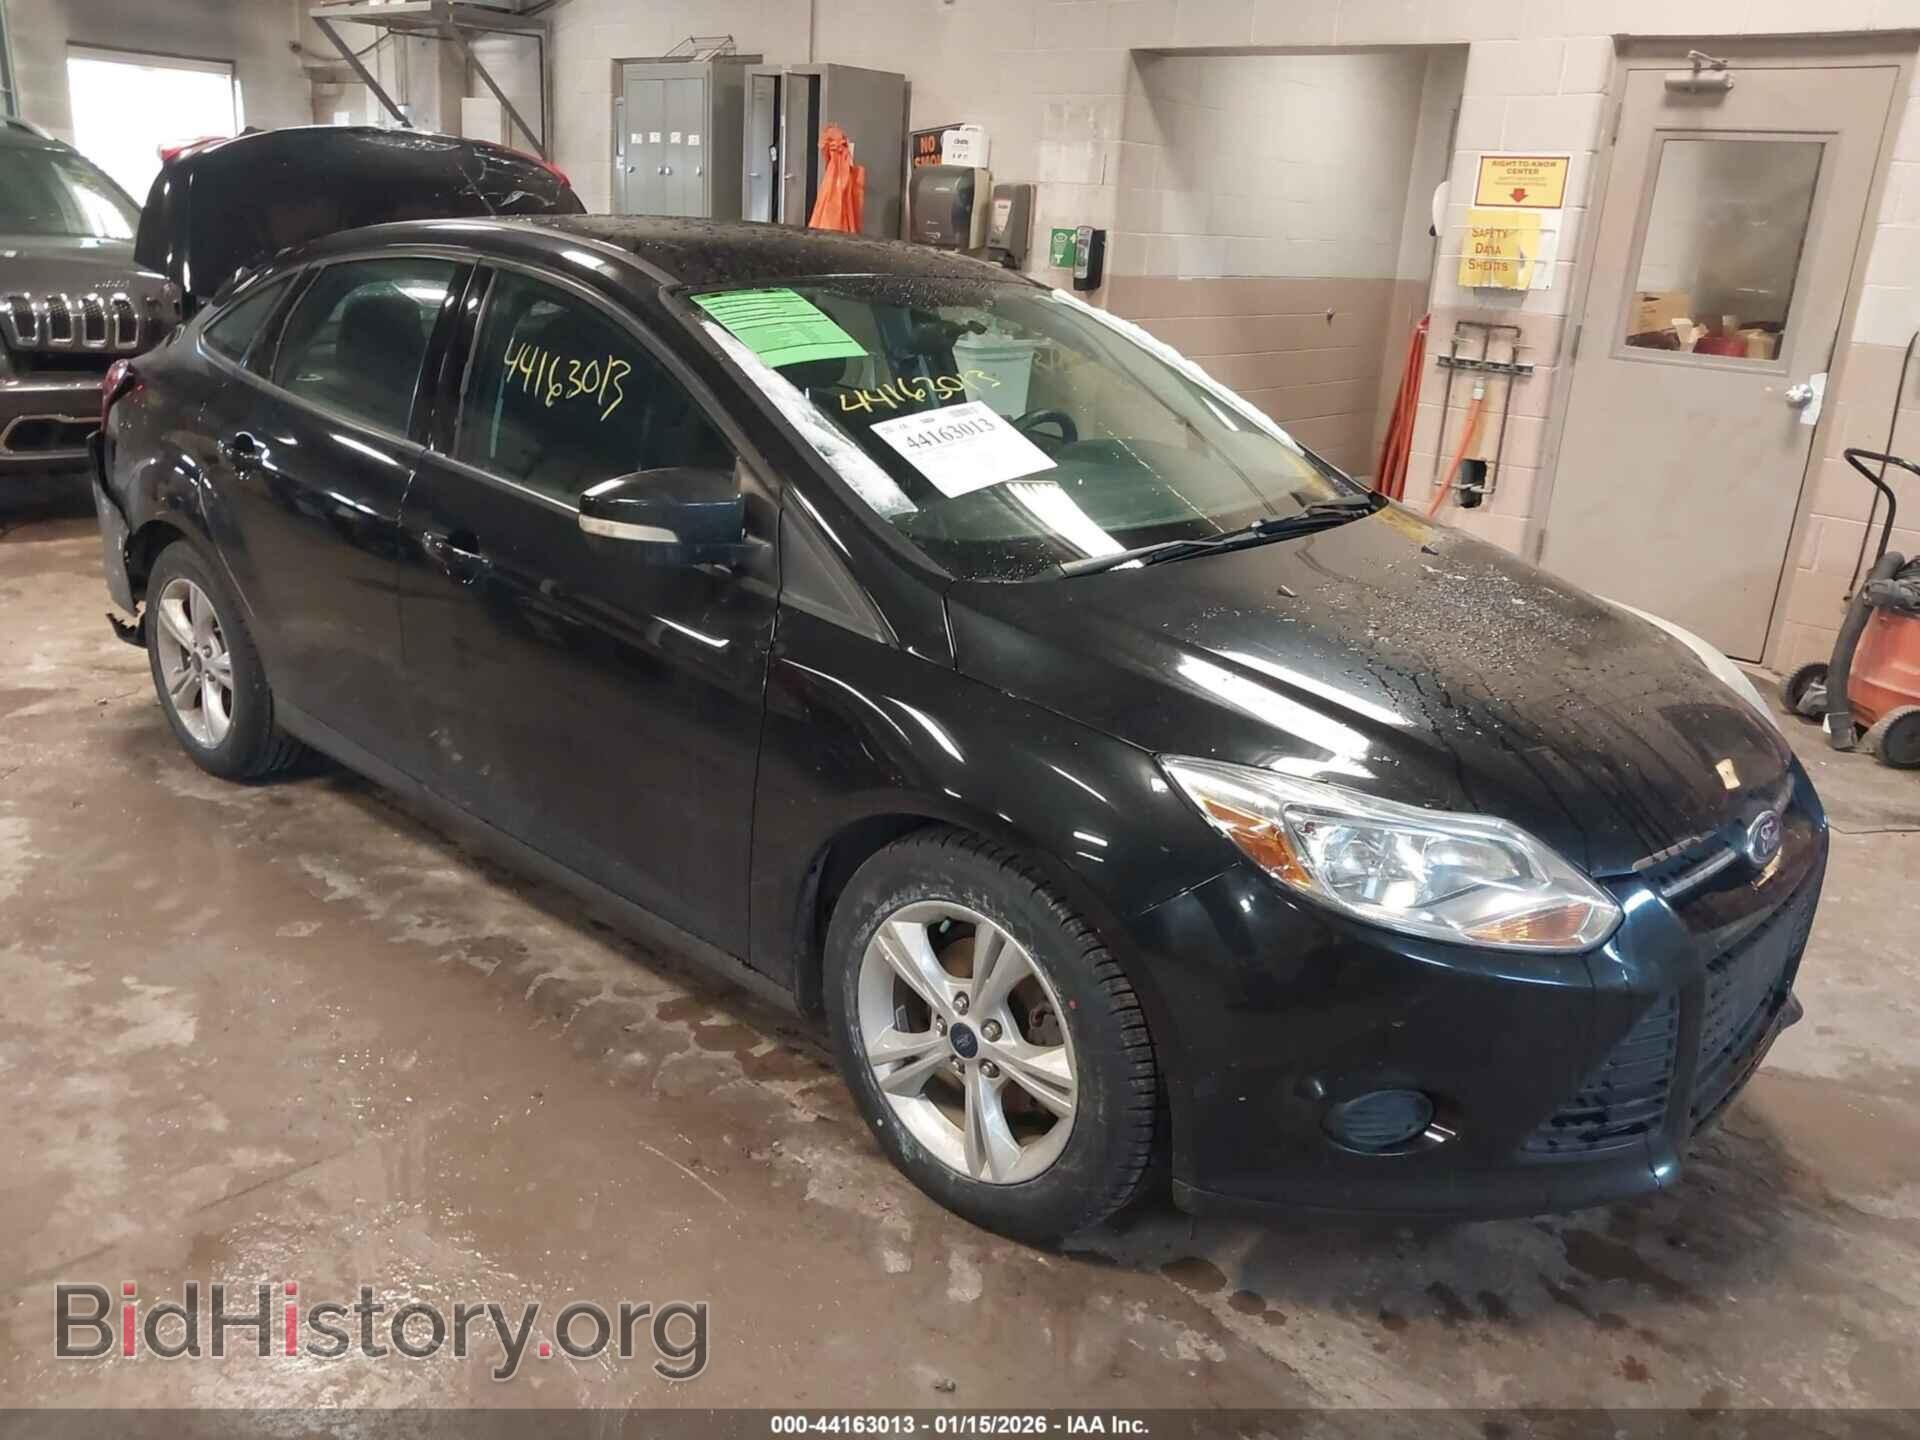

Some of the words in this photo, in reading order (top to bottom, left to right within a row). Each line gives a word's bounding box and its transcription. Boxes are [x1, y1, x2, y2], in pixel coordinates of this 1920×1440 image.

[920, 136, 936, 154] NO
[1471, 227, 1507, 239] SAFETY
[1475, 242, 1502, 256] DATA
[503, 337, 632, 422] 44163013
[839, 369, 1001, 413] 44163013
[906, 417, 996, 450] 44163013
